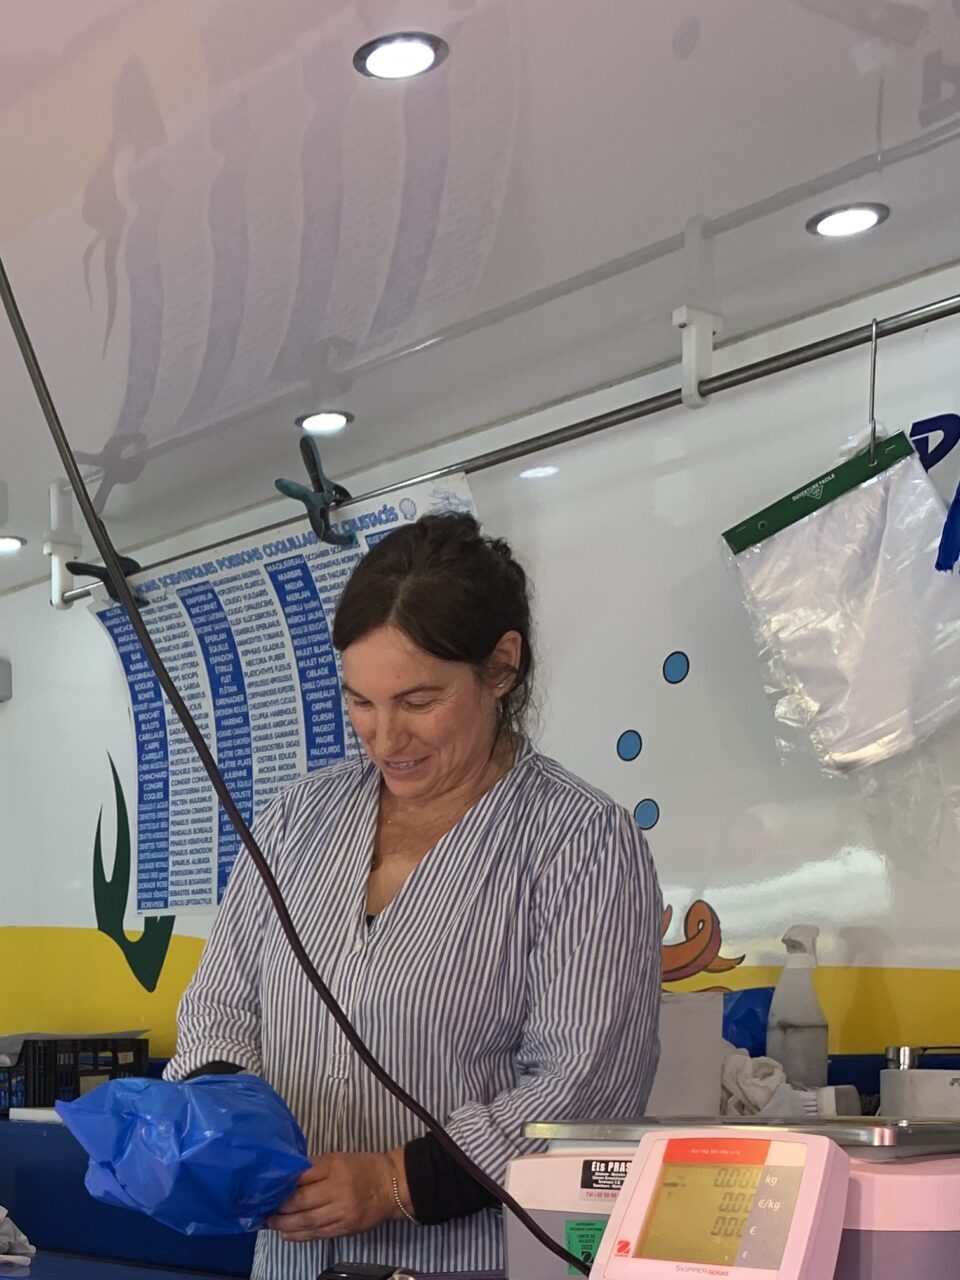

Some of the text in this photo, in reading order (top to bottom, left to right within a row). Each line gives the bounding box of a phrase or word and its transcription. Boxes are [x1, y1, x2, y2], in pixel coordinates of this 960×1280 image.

[591, 1161, 605, 1172] Ets
[765, 1174, 778, 1186] kg
[758, 1199, 780, 1211] €/kg
[750, 1226, 757, 1235] €
